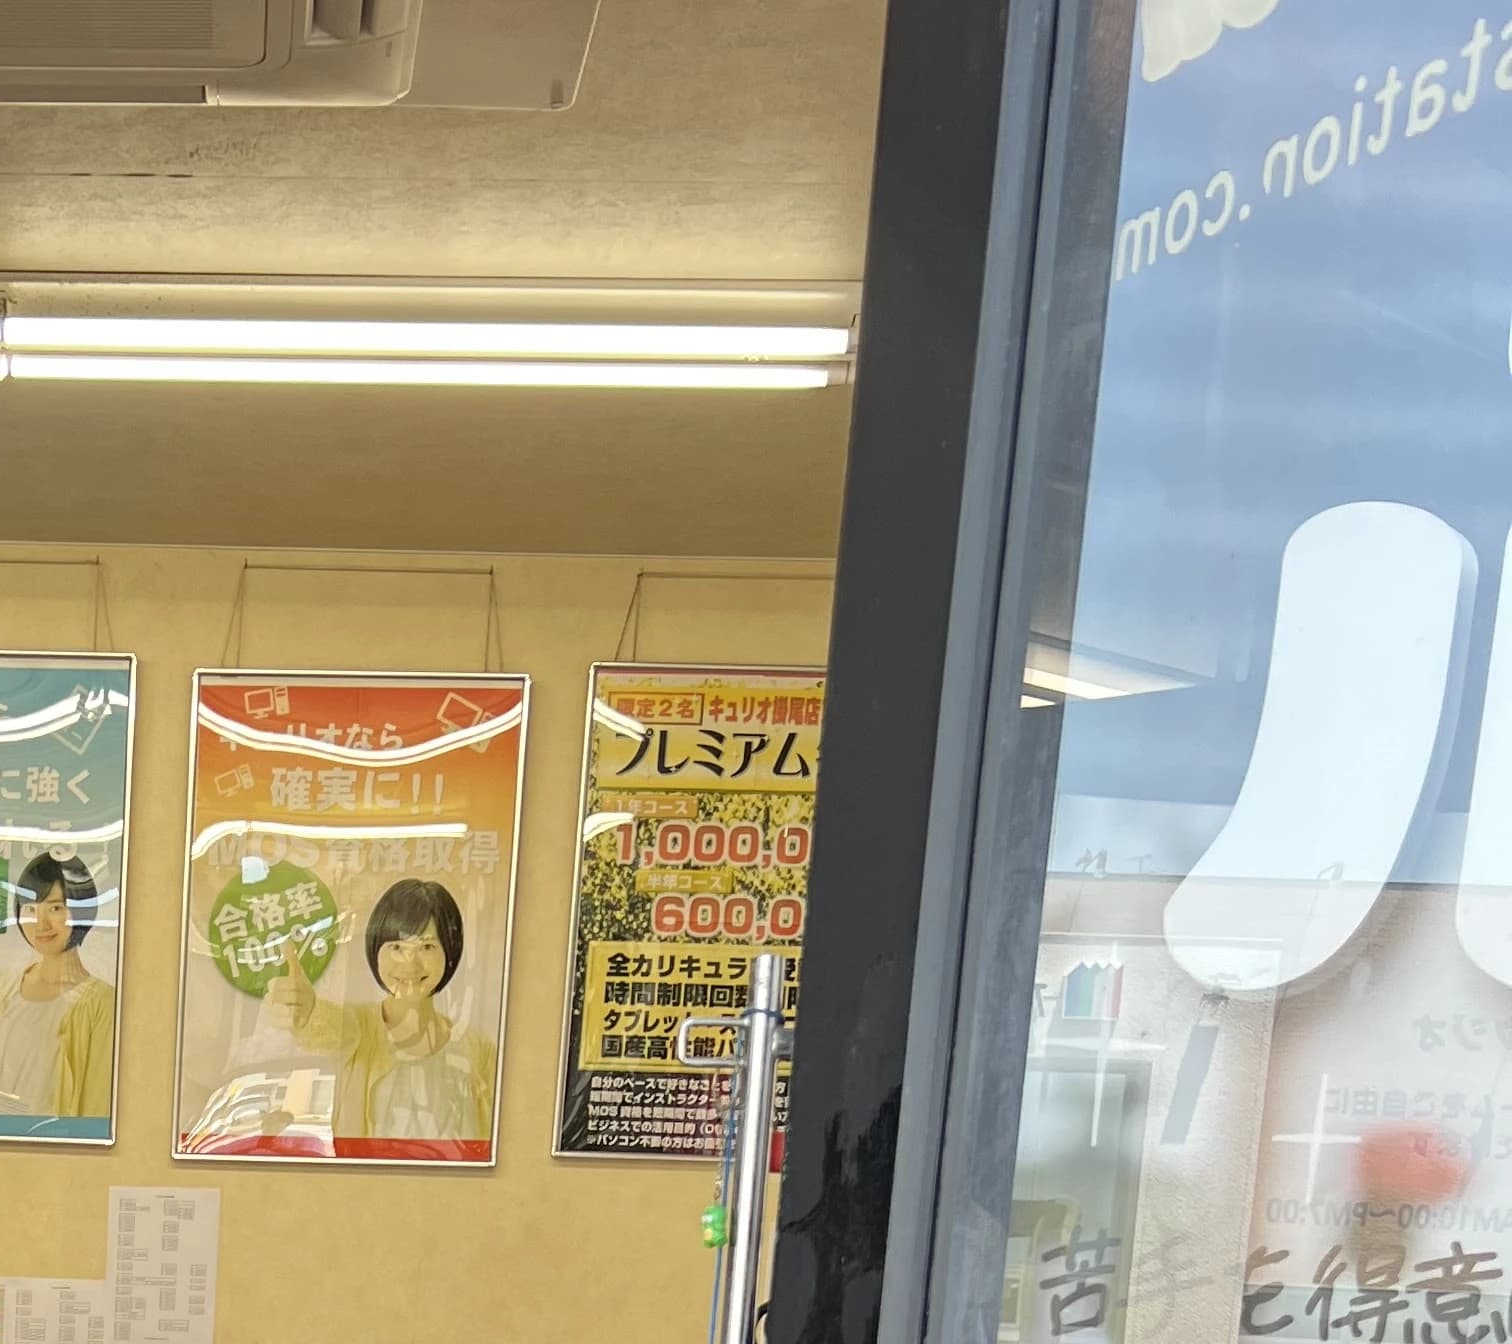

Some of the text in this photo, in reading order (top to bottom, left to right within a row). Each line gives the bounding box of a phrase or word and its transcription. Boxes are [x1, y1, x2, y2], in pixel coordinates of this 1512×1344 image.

[615, 729, 810, 778] プレミアム
[213, 881, 323, 942] 合格率
